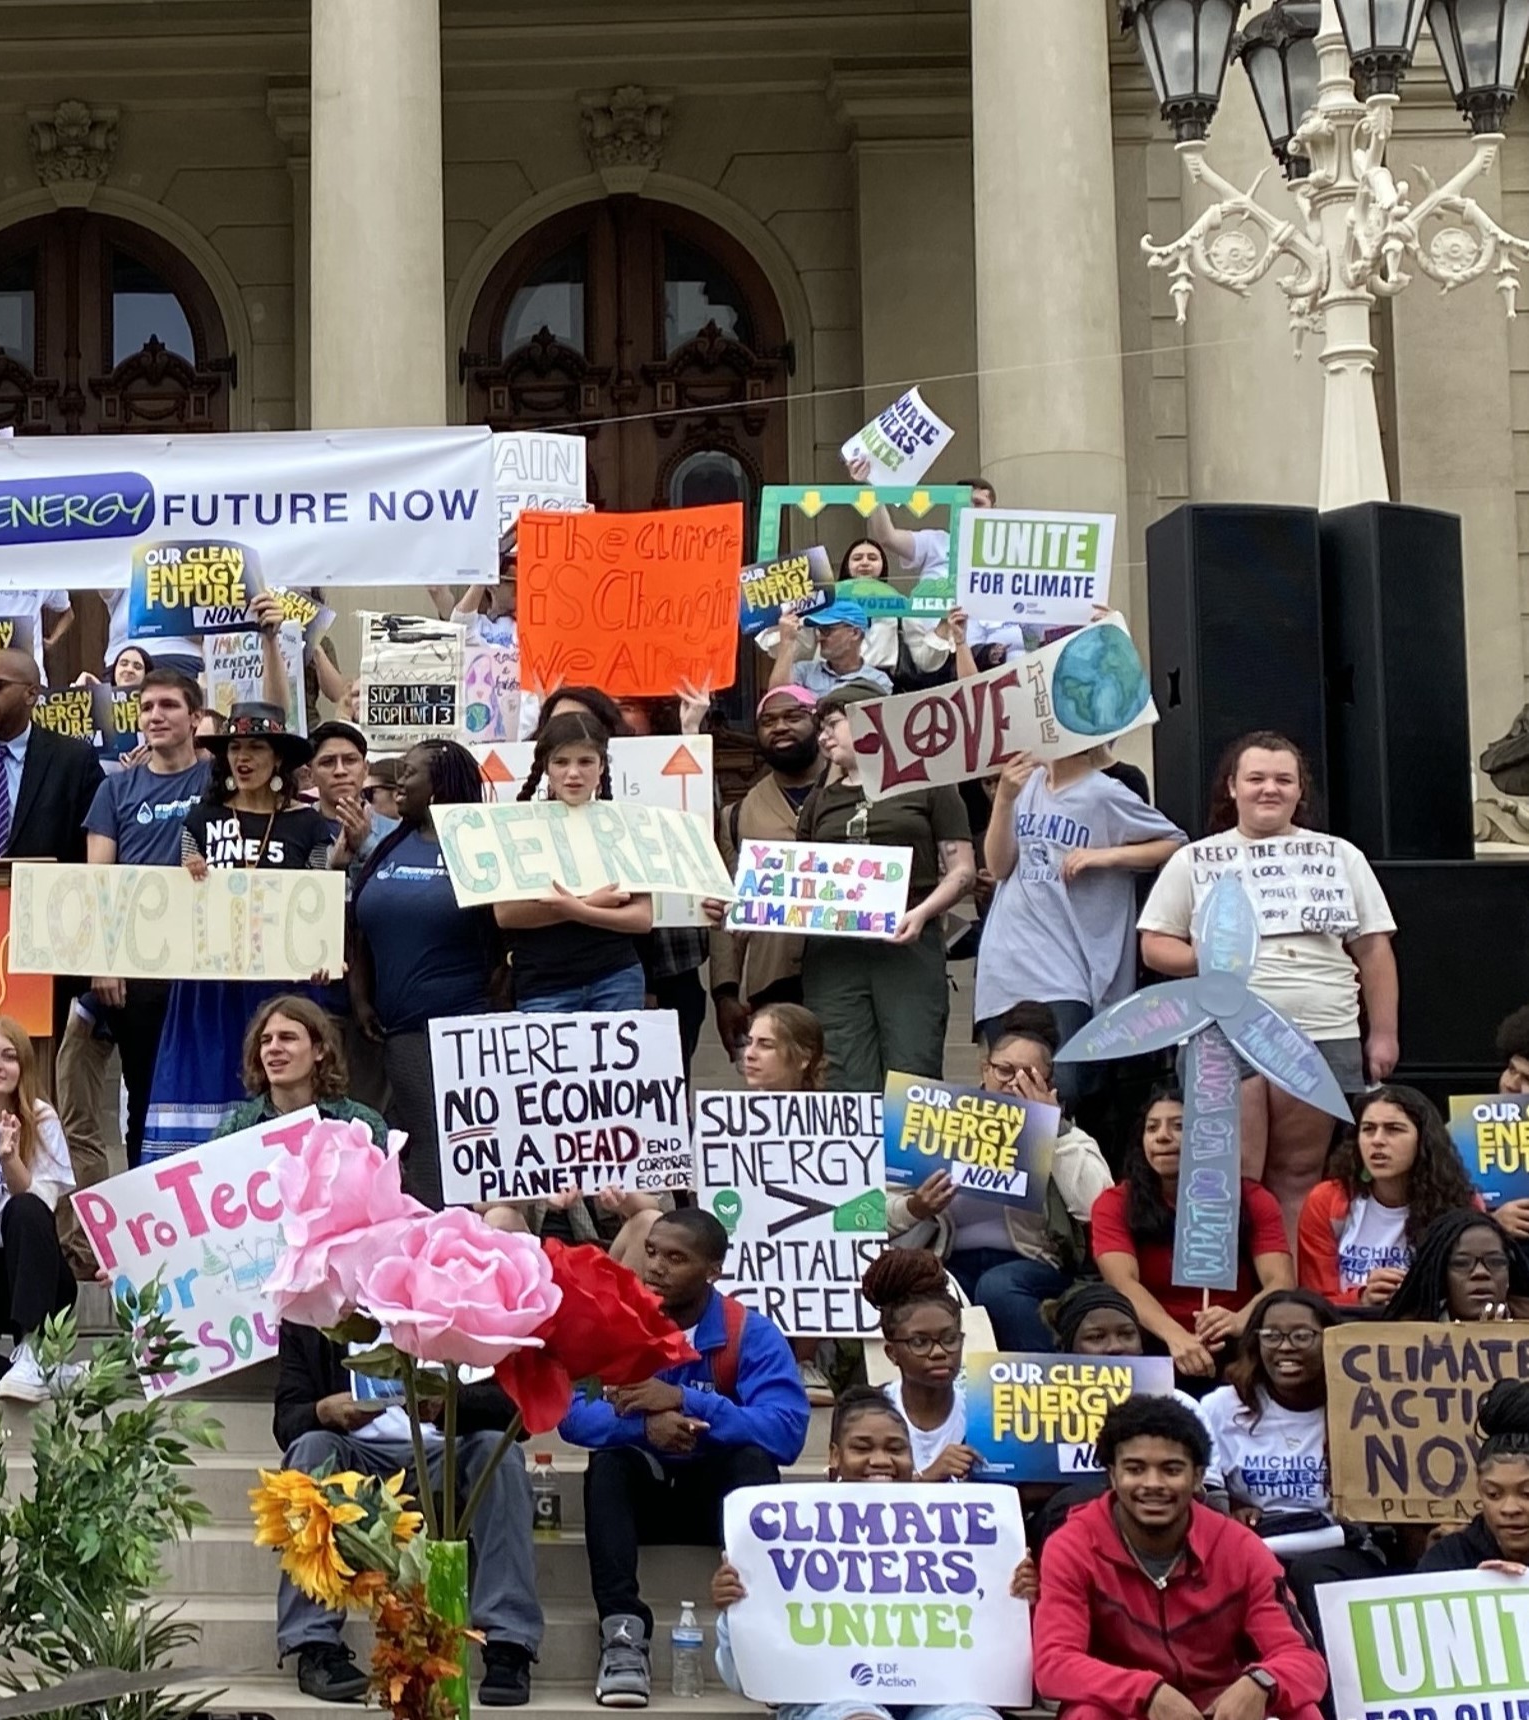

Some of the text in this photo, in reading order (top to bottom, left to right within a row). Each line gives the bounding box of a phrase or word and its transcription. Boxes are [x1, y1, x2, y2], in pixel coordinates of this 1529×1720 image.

[163, 492, 348, 526] FUTURE
[369, 489, 479, 522] NOW
[521, 514, 627, 563] The
[982, 521, 1088, 570] UNITE
[144, 547, 244, 565] OUR CLEAN
[767, 556, 809, 576] CLEAN
[146, 563, 245, 588] ENERGY
[743, 568, 810, 597] ENERGY
[970, 572, 1095, 598] FOR CLIMATE
[146, 583, 246, 610] FUTURE
[203, 606, 250, 625] NOW
[371, 686, 452, 703] STOP LINE 5
[370, 707, 451, 724] STOP LINE 3
[206, 820, 240, 842] NO
[206, 839, 284, 863] LINE 5
[442, 803, 583, 893] GET
[738, 869, 785, 897] AGE
[857, 859, 904, 882] OLD
[442, 1020, 640, 1080] THERE IS
[444, 1076, 685, 1131] NO ECONOMY
[701, 1095, 884, 1137] SUSTAINABLE
[907, 1085, 1026, 1123] OUR CLEAN
[903, 1104, 1022, 1143] ENERGY
[453, 1134, 545, 1175] ON A
[554, 1126, 642, 1164] DEAD
[899, 1127, 1019, 1172] FUTURE
[704, 1140, 880, 1188] ENERGY
[962, 1167, 1020, 1192] NOW
[990, 1363, 1132, 1387] OUR CLEAN
[992, 1384, 1132, 1416] ENERGY
[749, 1502, 998, 1546] CLIMATE
[767, 1550, 985, 1600] VOTERS,
[786, 1602, 973, 1650] UNITE!
[876, 1674, 917, 1687] Action
[877, 1663, 899, 1674] EDF
